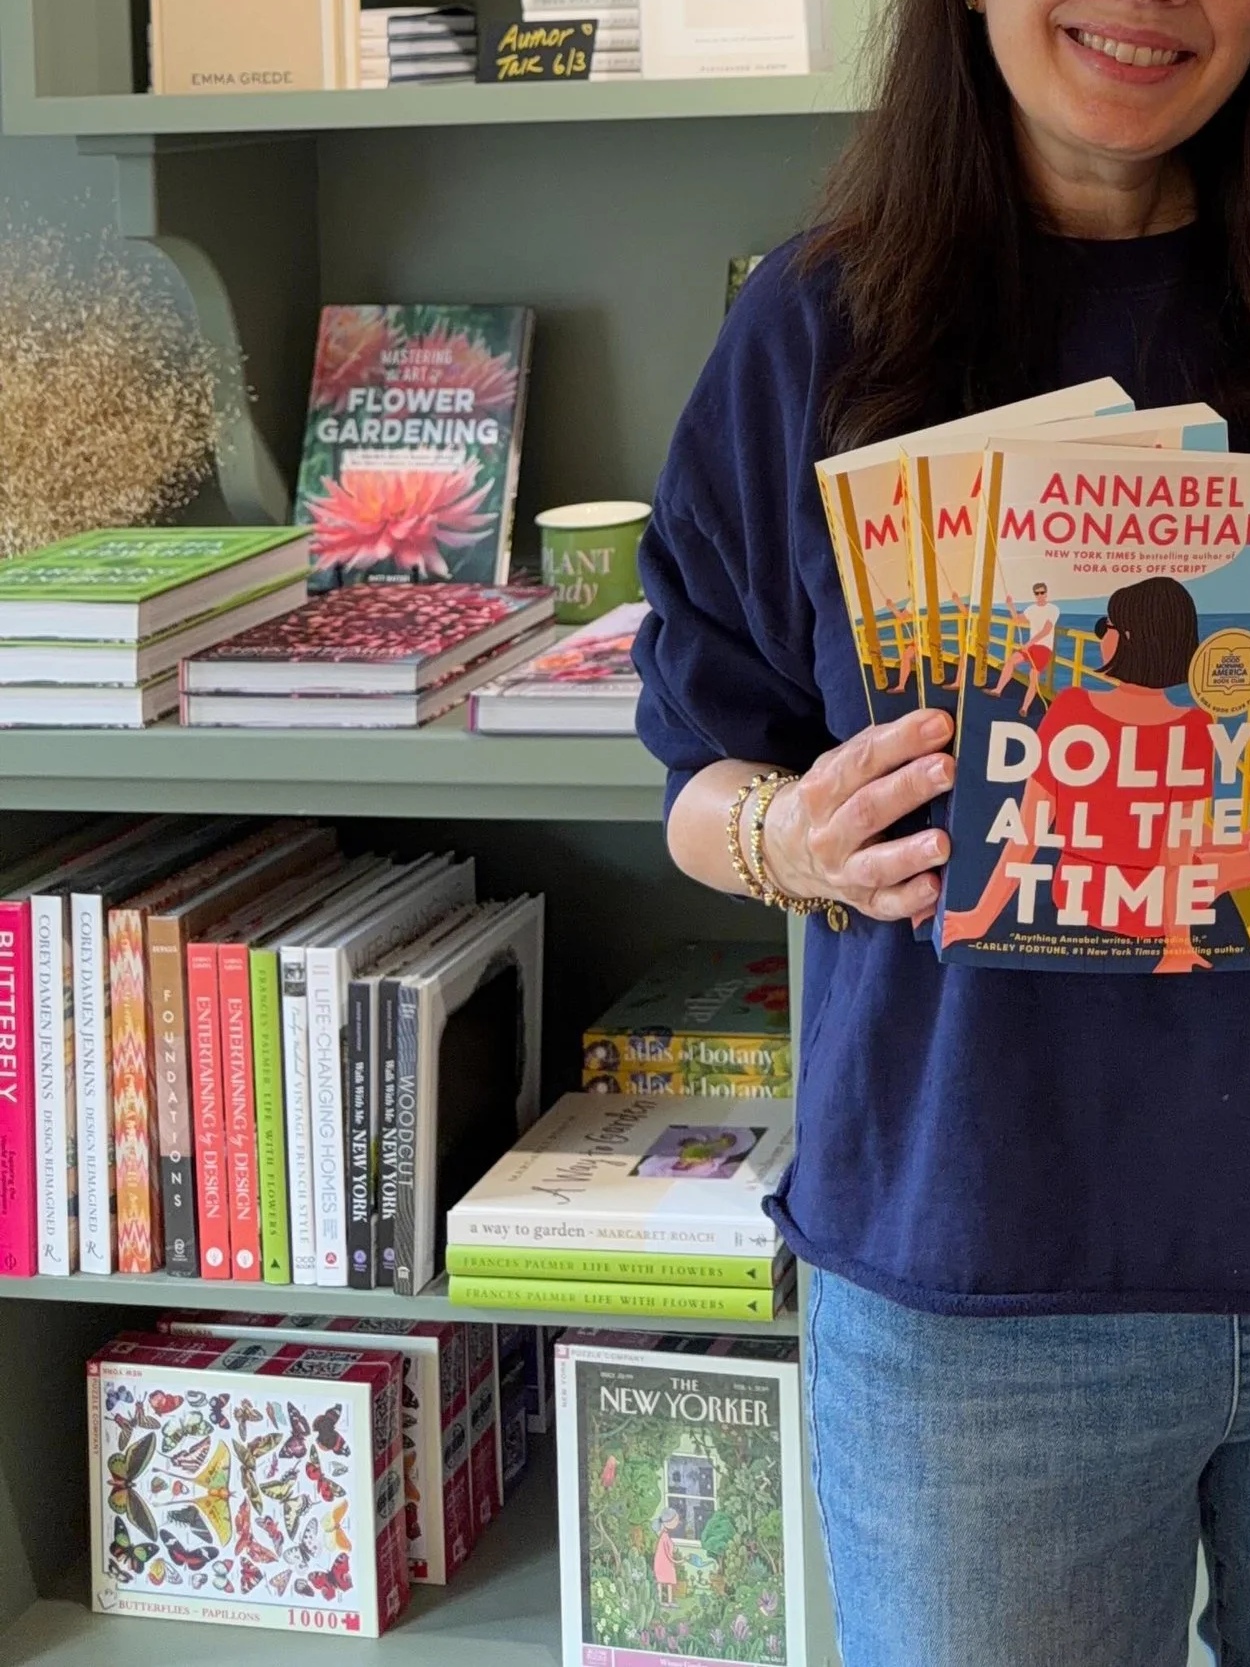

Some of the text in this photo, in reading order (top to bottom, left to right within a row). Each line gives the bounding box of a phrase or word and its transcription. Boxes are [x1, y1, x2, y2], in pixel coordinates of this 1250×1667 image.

[191, 70, 293, 86] EMMA GREDE
[552, 52, 587, 77] 6/3
[380, 349, 452, 365] MASTERING
[347, 388, 475, 414] FLOWER
[317, 418, 499, 445] GARDENING
[1040, 472, 1244, 508] ANNABEL
[1045, 550, 1236, 562] NEW YORK TIMES bestselling author of
[1073, 564, 1207, 573] NORA GOES OFF SCRIPT
[986, 798, 1244, 849] ALL THE
[1005, 863, 1219, 926] TIME
[700, 1040, 774, 1074] botany
[38, 915, 55, 1236] COREY DAMEN JENKINS DESIGN REIMAGINED
[80, 911, 98, 1232] COREY DAMEN JENKINS DESIGN REIMAGINED
[163, 990, 183, 1207] FOUNDATIONS
[399, 1075, 415, 1189] WOODCUT
[382, 1126, 397, 1219] NEW YORK
[470, 1223, 714, 1243] a way to garden MARGARET ROACH
[466, 1289, 725, 1310] FRANCES PALMER LIFE WITH FLOWERS
[670, 1377, 700, 1391] THE
[600, 1386, 770, 1426] NEW YORKER
[118, 1600, 337, 1628] BUTTERFLIES PAPILLONS 1000
